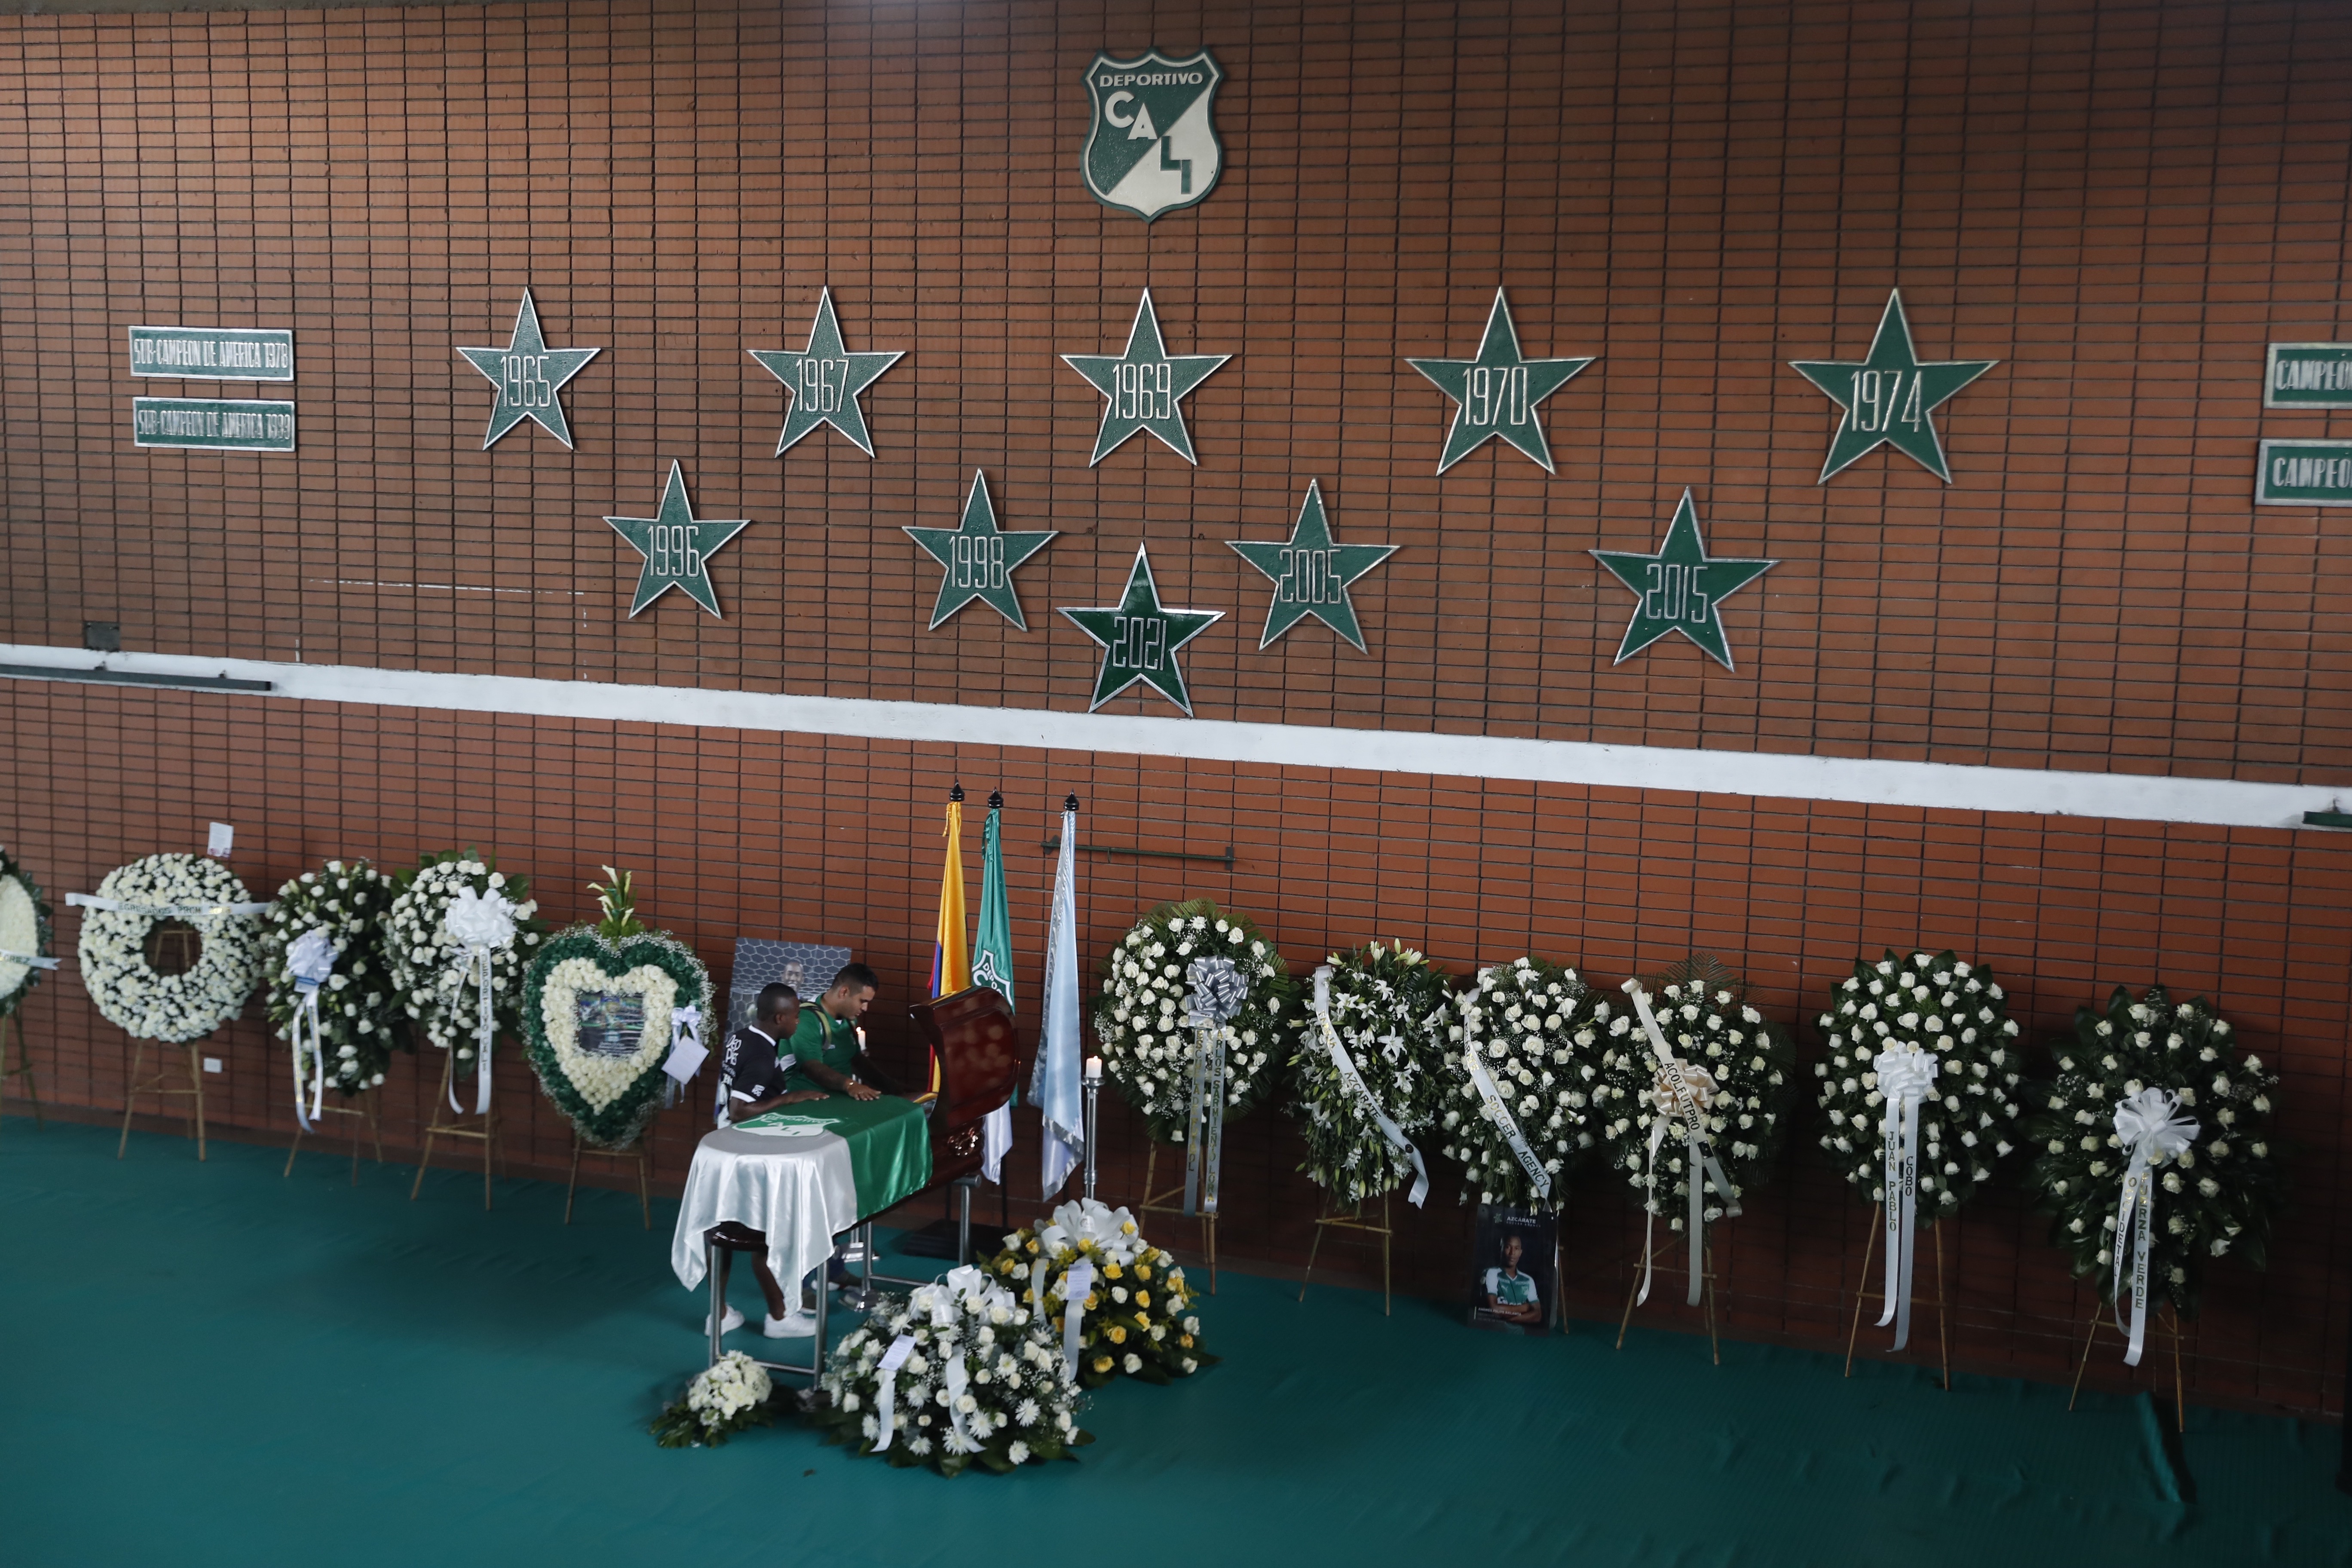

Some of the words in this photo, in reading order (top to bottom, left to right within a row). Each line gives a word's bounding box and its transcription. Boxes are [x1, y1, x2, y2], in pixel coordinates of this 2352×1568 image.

[1100, 73, 1203, 87] DEPORTIVO
[1105, 91, 1191, 194] CALI
[203, 341, 217, 366] DE
[219, 342, 261, 368] AMERICA
[263, 343, 288, 368] 1978
[500, 355, 551, 407] 1965
[796, 359, 849, 413] 1967
[1113, 364, 1171, 419] 1969
[1463, 368, 1527, 426] 1970
[1851, 371, 1921, 433] 1974
[206, 412, 220, 437] DE
[222, 413, 263, 438] AMERICA
[2272, 457, 2352, 488] CAMPEO
[647, 526, 699, 577] 1996
[949, 536, 1004, 589] 1998
[1280, 549, 1341, 604] 2005
[1646, 564, 1708, 623] 2015
[1113, 617, 1167, 671] 2021
[481, 953, 490, 1031] DEPORTIVO
[1193, 1029, 1204, 1095] ESCUELA
[1214, 1021, 1224, 1077] CARLOS
[1209, 1079, 1221, 1161] SARMIENTO
[1664, 1063, 1700, 1130] ACOLFUTPRO
[1485, 1095, 1516, 1139] SOCCER
[1519, 1150, 1550, 1188] AGENCY
[1207, 1165, 1216, 1203] LORA
[1905, 1156, 1914, 1196] COBO
[1888, 1181, 1896, 1231] PABLO
[2138, 1172, 2149, 1241] FUERZA
[2135, 1251, 2146, 1309] VERDE
